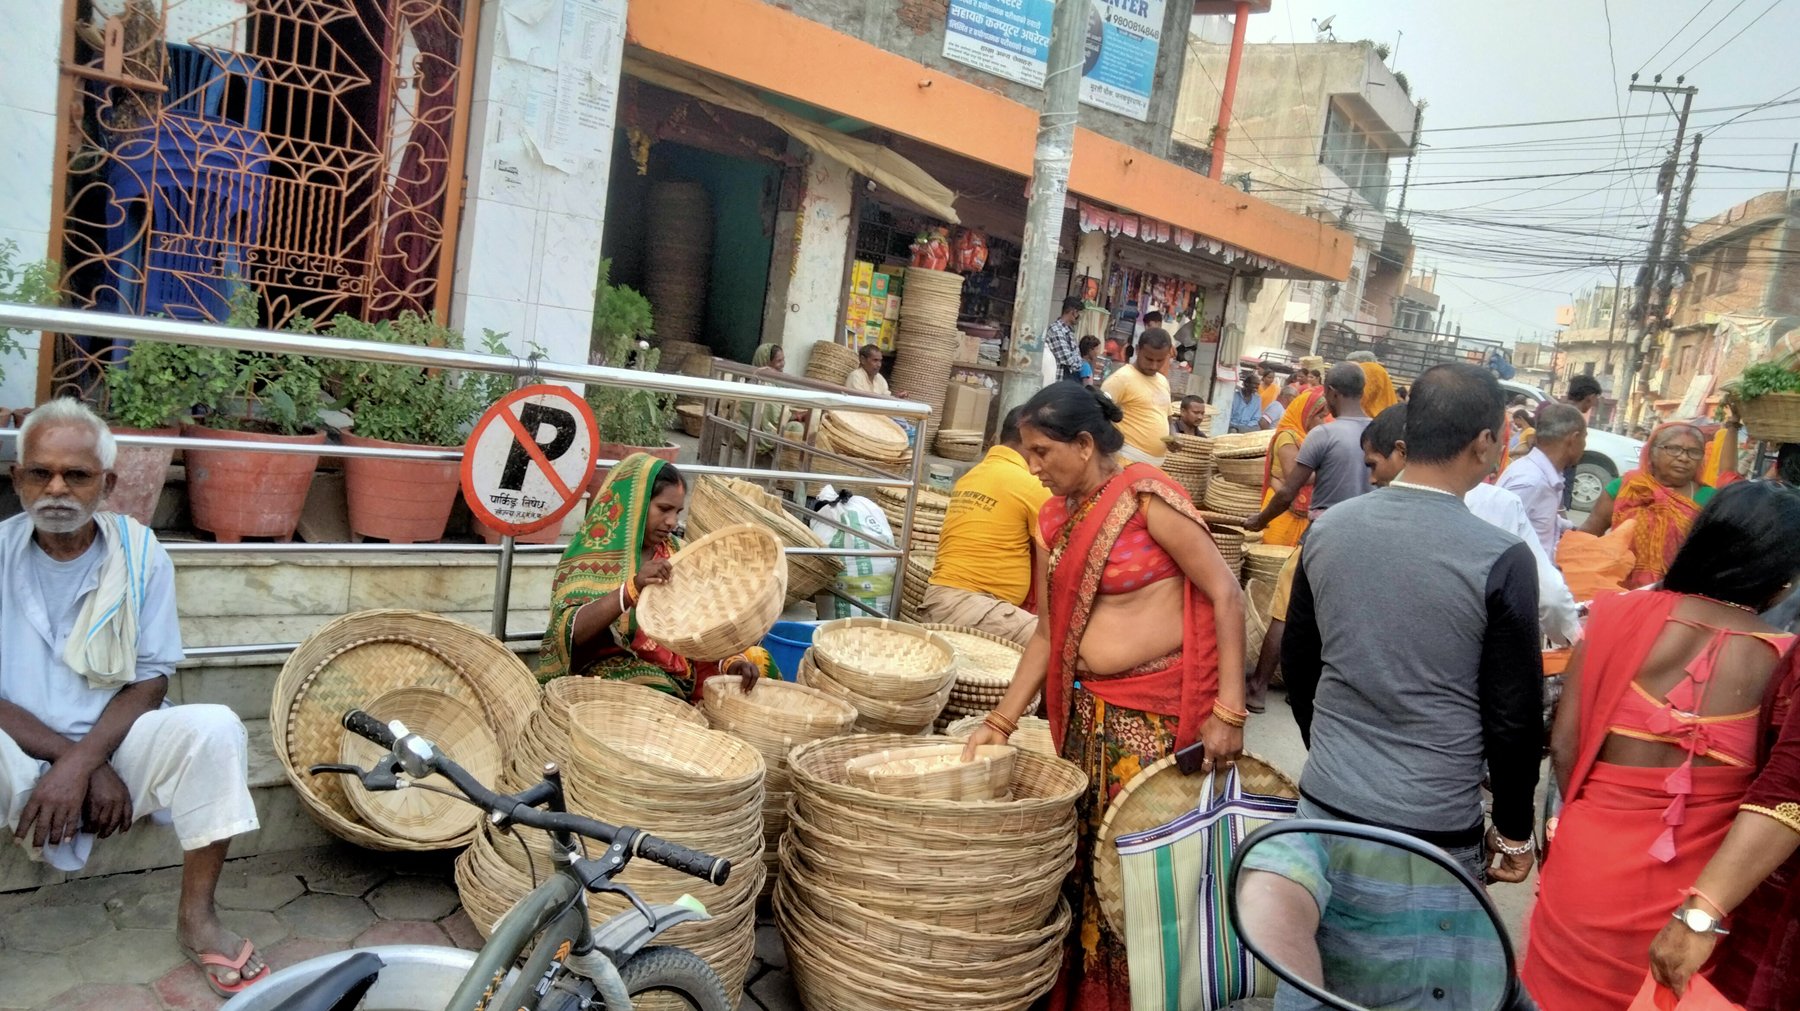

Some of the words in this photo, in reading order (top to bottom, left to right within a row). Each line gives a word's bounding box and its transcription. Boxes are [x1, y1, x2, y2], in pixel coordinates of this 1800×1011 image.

[951, 5, 984, 24] सहायक
[1113, 14, 1159, 40] 9800814848
[498, 402, 577, 491] P
